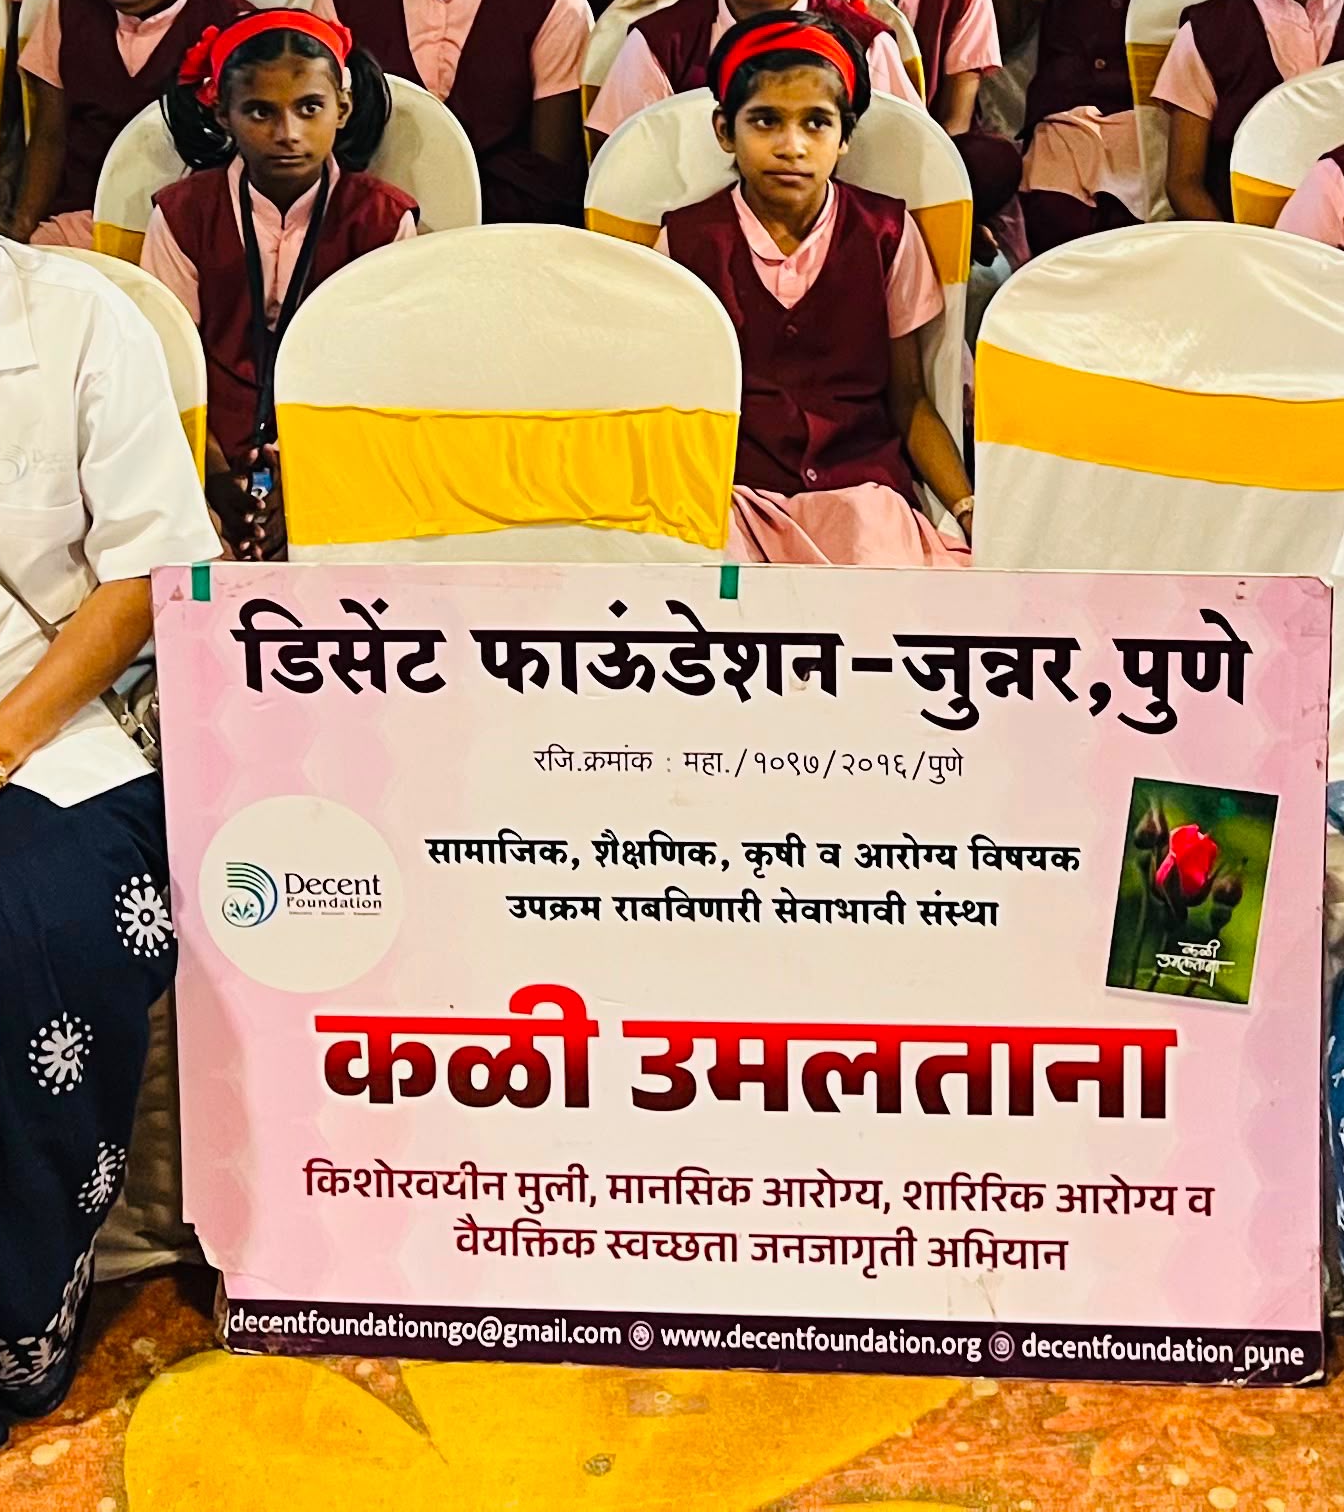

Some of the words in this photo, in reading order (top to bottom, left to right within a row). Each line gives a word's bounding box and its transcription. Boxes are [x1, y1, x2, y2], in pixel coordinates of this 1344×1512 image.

[229, 597, 448, 695] डिसेंट
[424, 827, 580, 872] सामाजिक,
[590, 828, 730, 874] शैक्षणिक,
[740, 832, 807, 879] कृषी
[815, 842, 842, 870] व
[854, 832, 958, 872] आरोग्य
[967, 834, 1082, 873] विषयक
[284, 872, 382, 896] Decent
[286, 896, 383, 909] Foundation
[505, 894, 602, 922] उपक्रम
[611, 885, 763, 924] राबविणारी
[771, 886, 907, 925] सेवाभावी
[915, 889, 1000, 927] संस्था
[314, 983, 600, 1110] कळी
[621, 1020, 1179, 1112] उमलताना
[302, 1157, 507, 1201] किशोरवयीन
[514, 1163, 597, 1214] मुली,
[605, 1165, 754, 1207] मानसिक
[762, 1167, 892, 1215] आरोग्य,
[902, 1171, 1047, 1213] शारिरिक
[1056, 1173, 1179, 1216] आरोग्य
[1185, 1186, 1216, 1217] व
[453, 1214, 596, 1259] वैयक्तिक
[604, 1230, 739, 1263] स्वच्छता
[748, 1226, 918, 1279] जनजागृती
[927, 1228, 1069, 1271] अभियान
[230, 1308, 622, 1350] decentfoundationngo@gmail.com
[660, 1320, 983, 1362] www.decentfoundation.org
[1021, 1333, 1306, 1372] decentfoundation_pune
